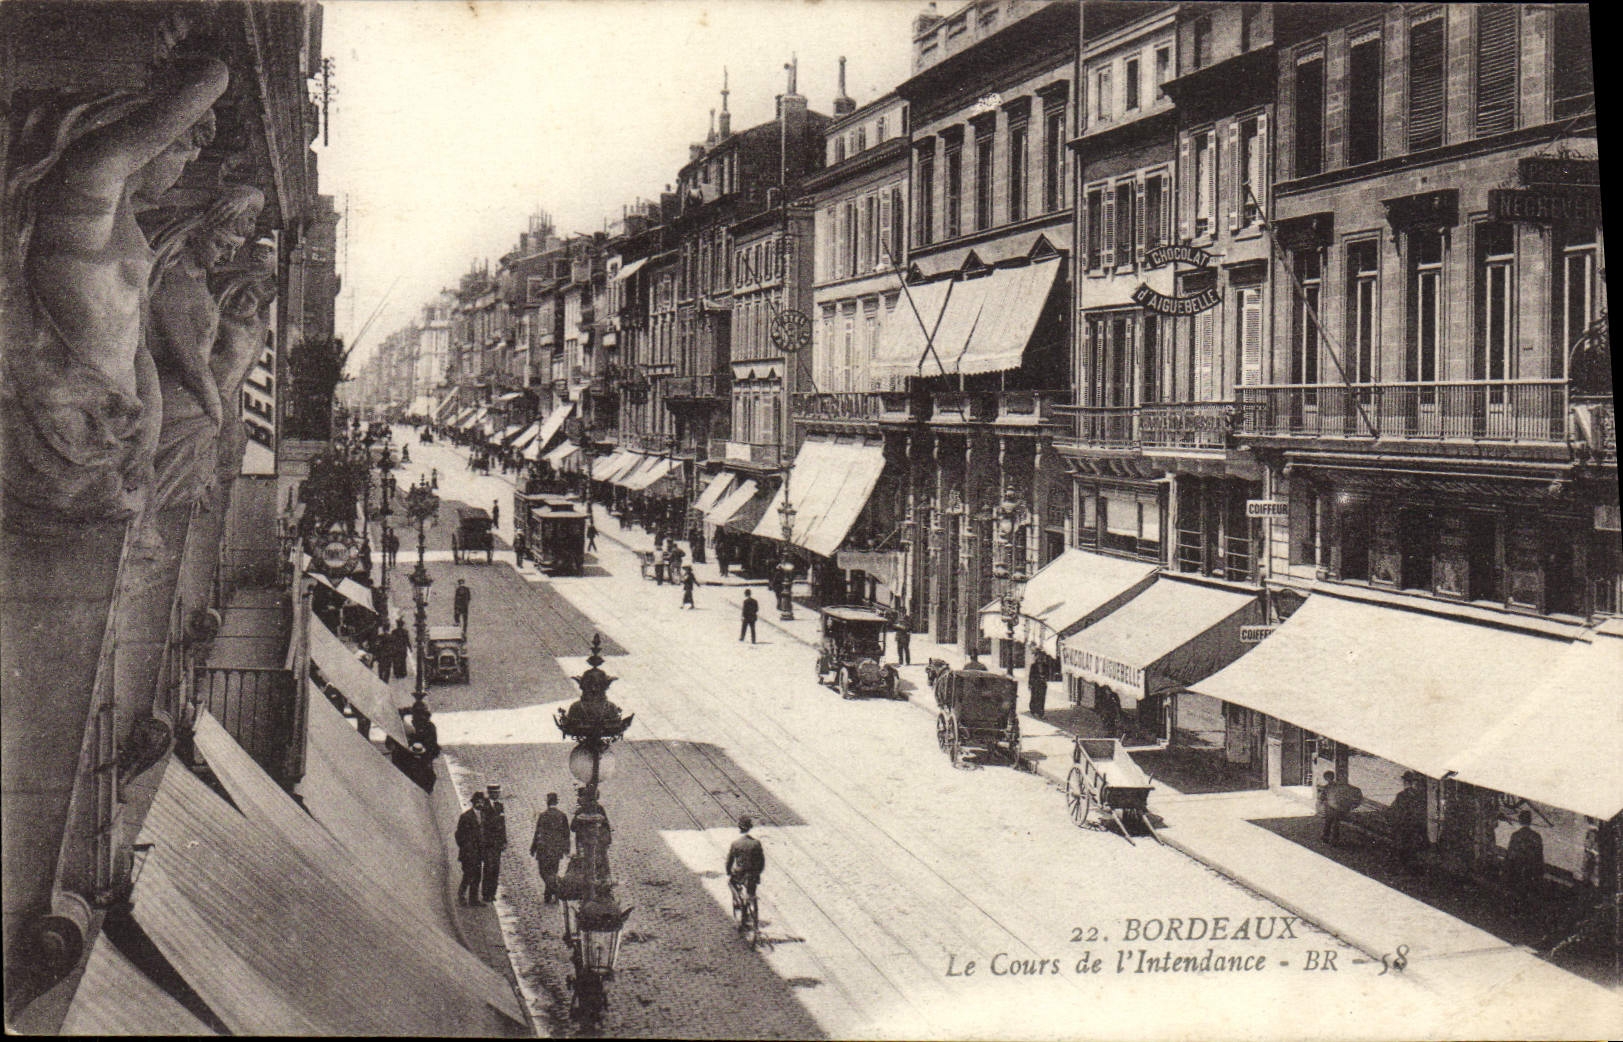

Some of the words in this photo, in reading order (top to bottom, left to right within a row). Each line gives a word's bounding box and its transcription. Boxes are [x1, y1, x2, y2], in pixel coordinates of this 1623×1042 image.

[1152, 246, 1209, 267] CHOCOLAT
[1137, 288, 1220, 315] d'AIGUEBELLE
[1248, 503, 1289, 516] COIFFEUR
